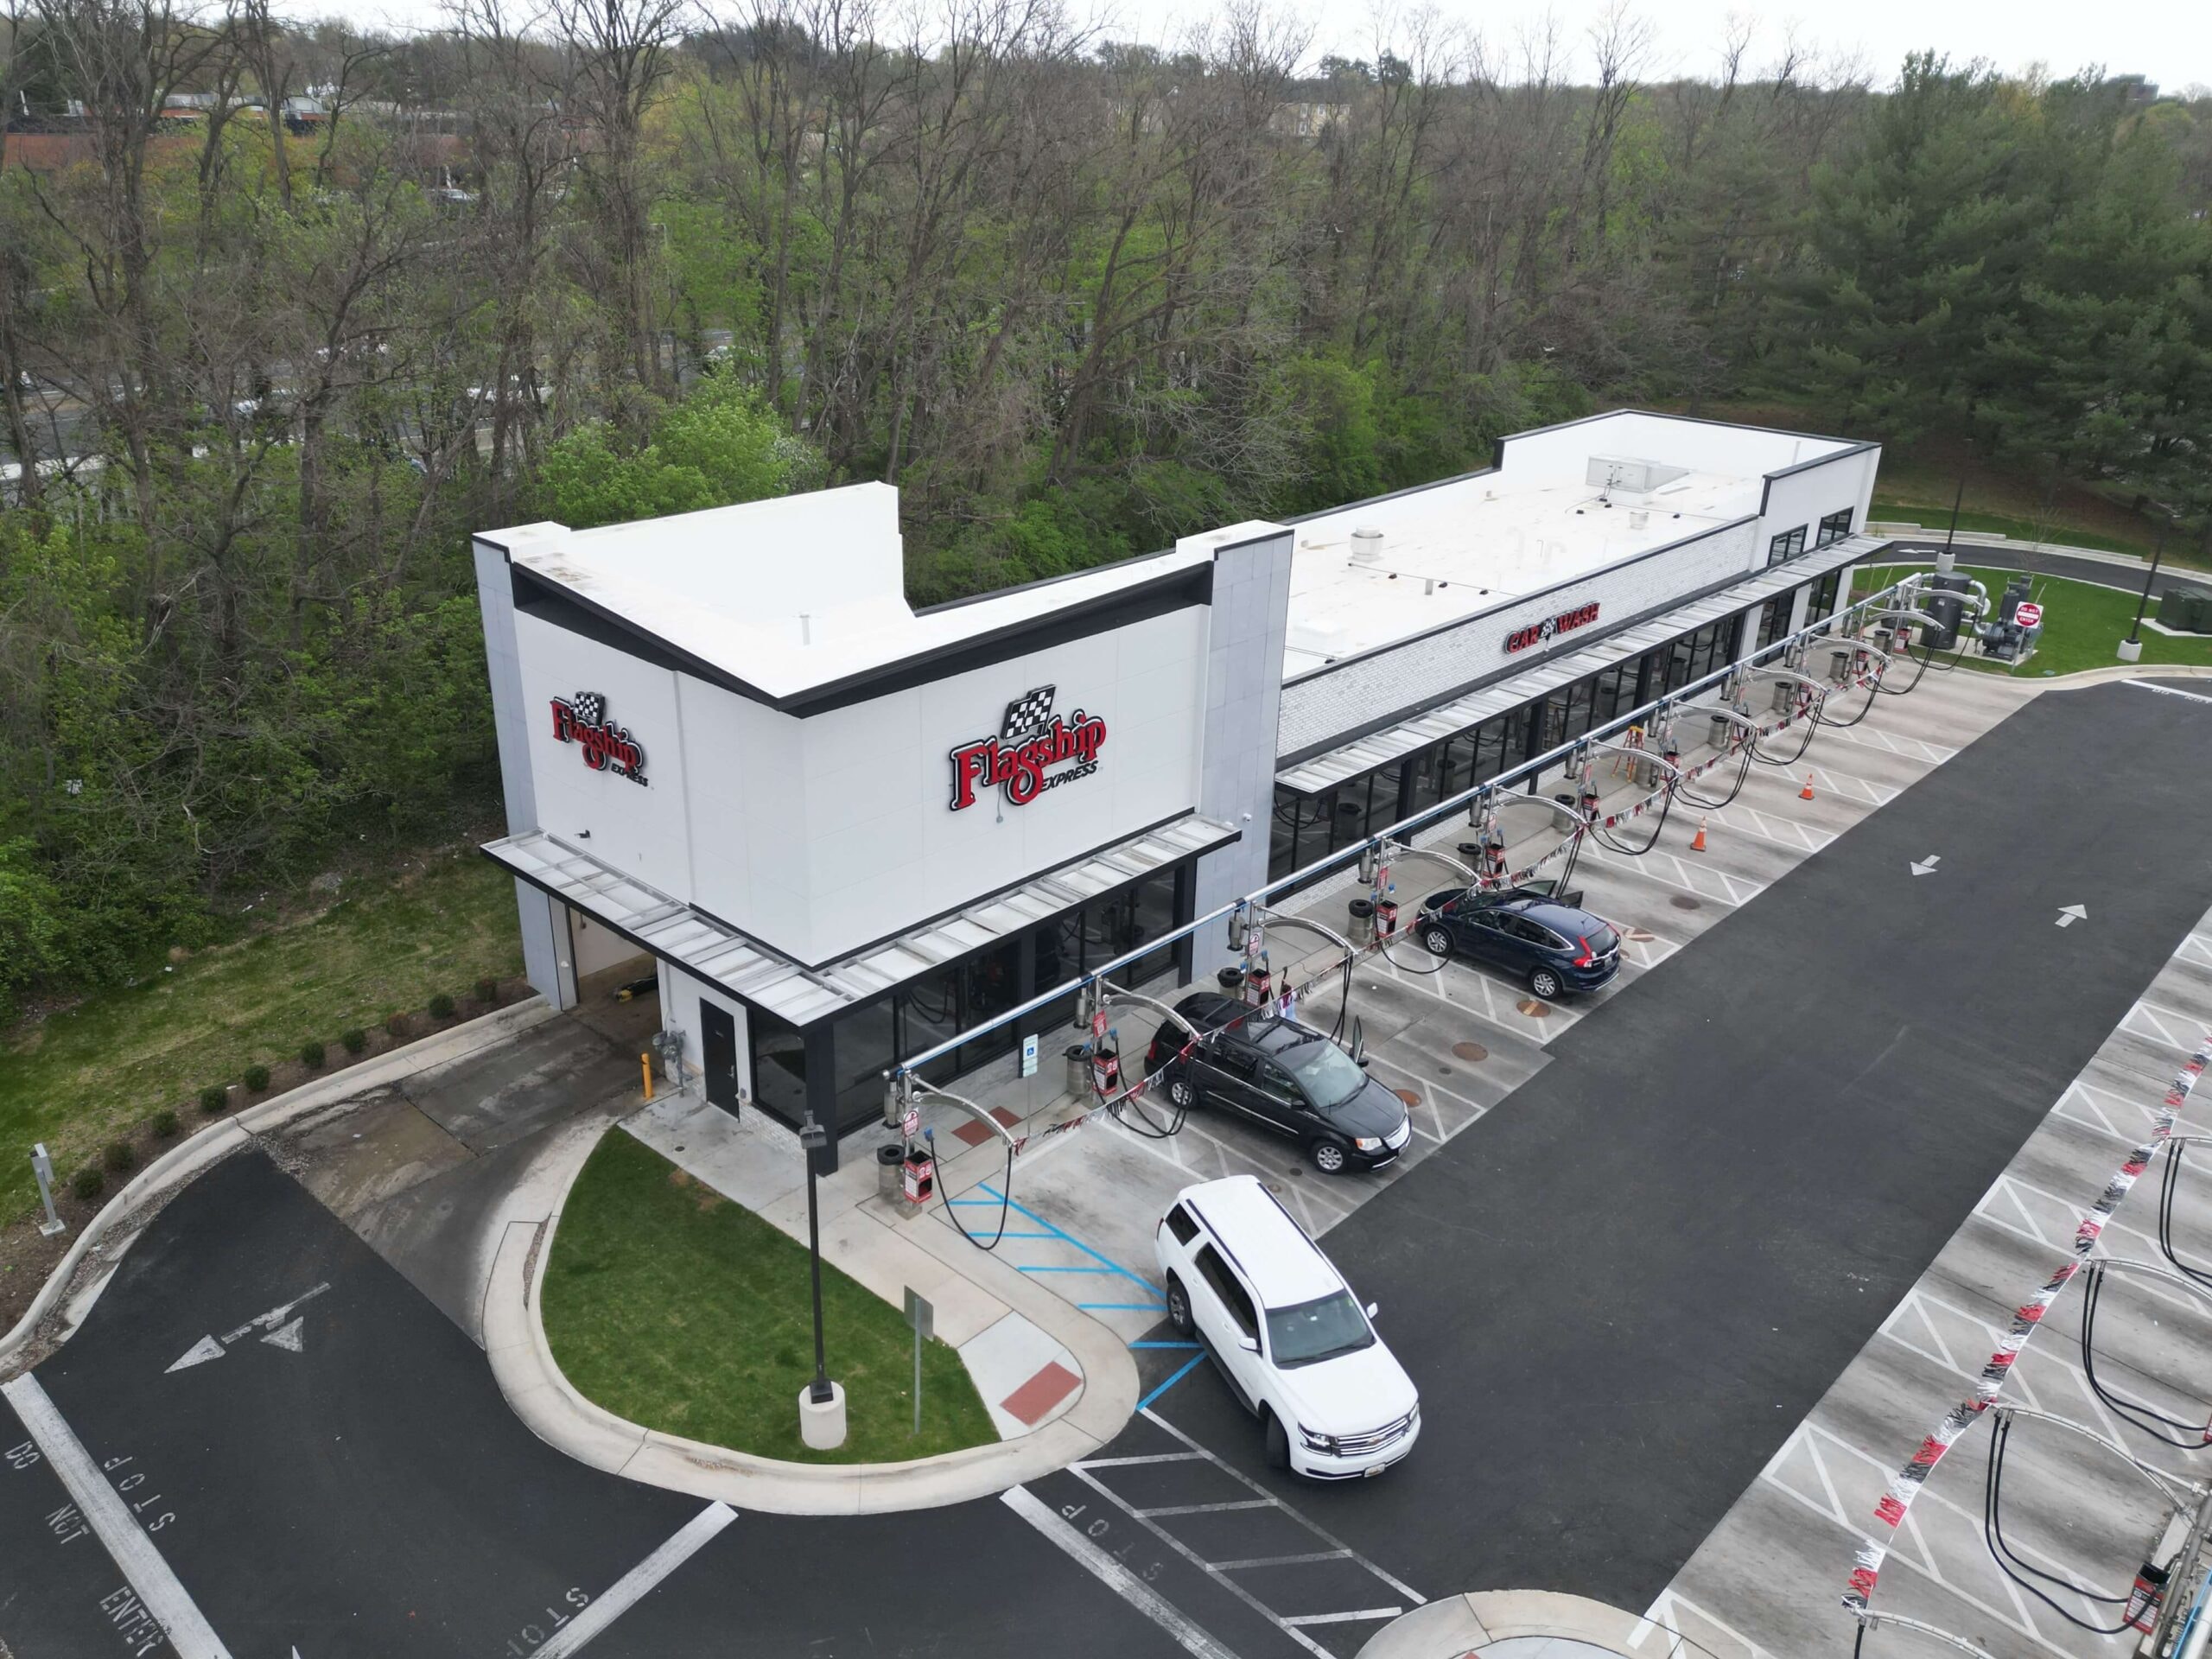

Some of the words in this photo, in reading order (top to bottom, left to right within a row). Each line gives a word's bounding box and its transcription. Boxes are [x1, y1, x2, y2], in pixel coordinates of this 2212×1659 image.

[1505, 625, 1539, 653] CAR
[1556, 601, 1600, 634] WASH
[550, 697, 643, 771] Flagship
[950, 709, 1106, 810] Flagship
[1040, 760, 1098, 791] EXPRESS
[104, 1456, 176, 1531] STOP
[4, 1440, 41, 1470] DO
[45, 1503, 90, 1544] NOT
[99, 1586, 164, 1657] ENTER
[1061, 1504, 1164, 1580] STOP
